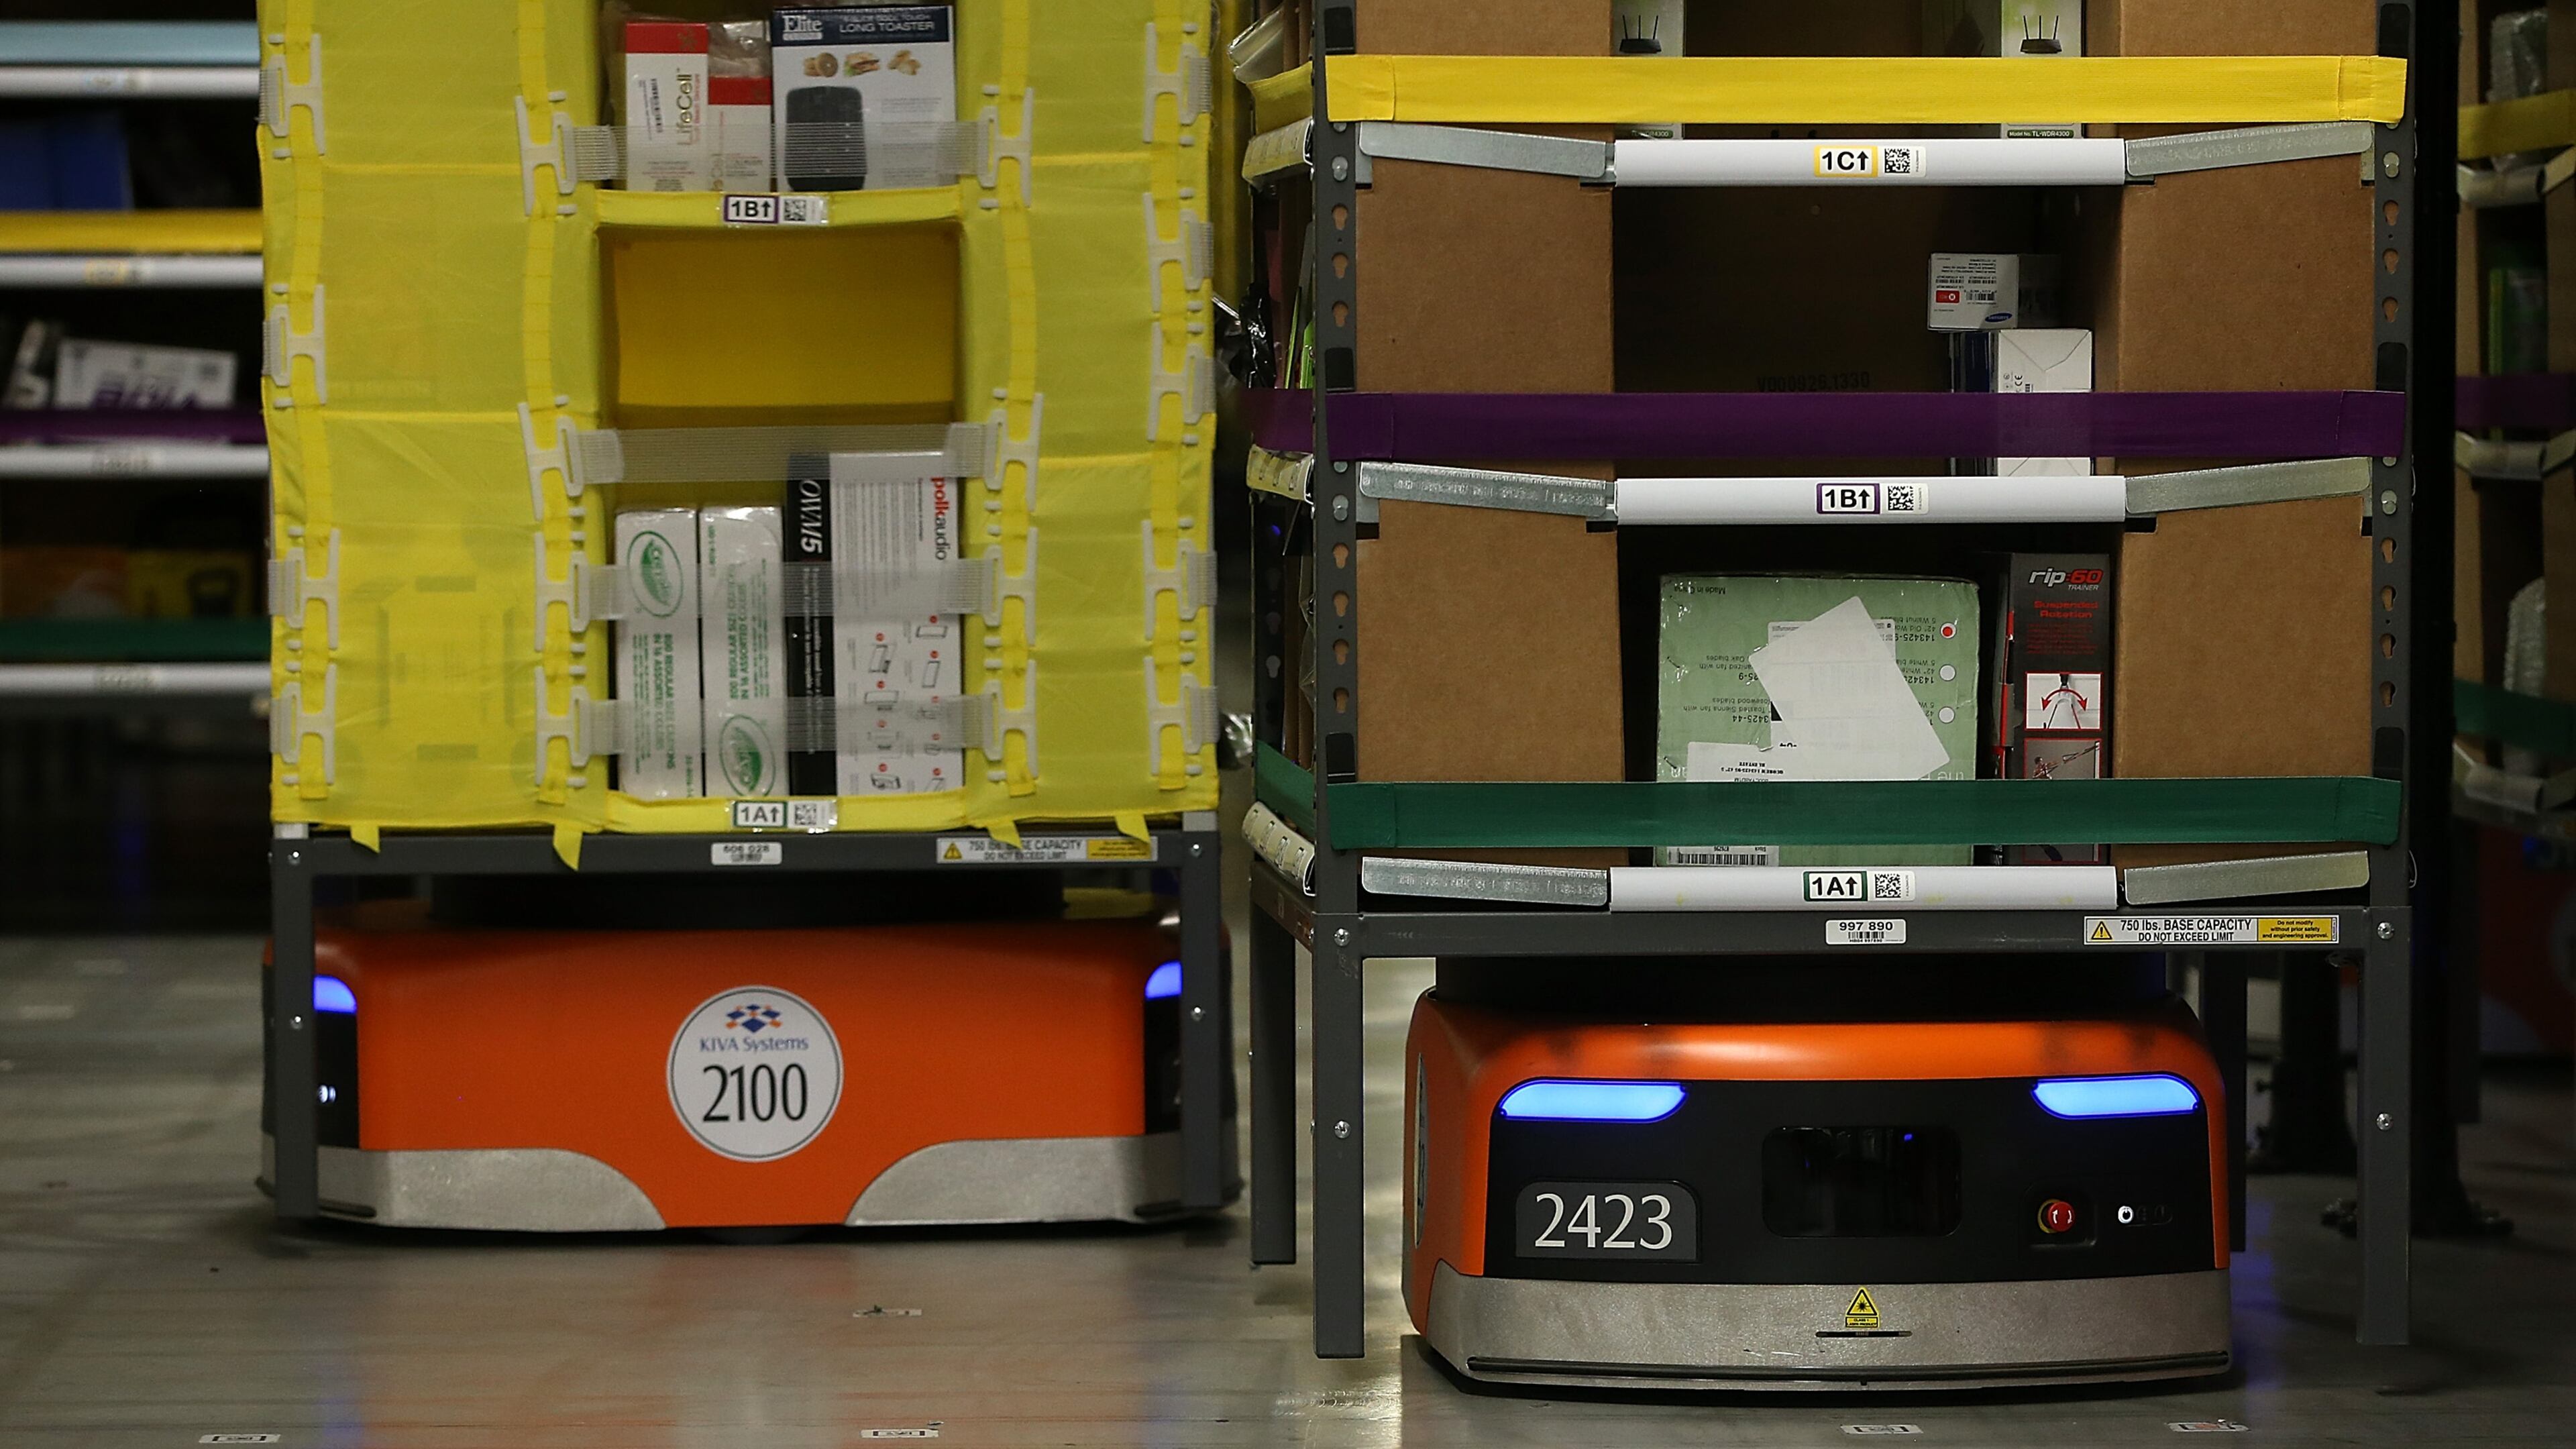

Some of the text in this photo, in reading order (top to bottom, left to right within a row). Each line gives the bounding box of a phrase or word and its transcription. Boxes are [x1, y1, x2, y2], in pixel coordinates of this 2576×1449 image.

[782, 15, 824, 32] Elite
[839, 21, 935, 33] LONG TOASTER
[1821, 151, 1855, 170] 1C
[731, 201, 759, 217] 1B
[1825, 488, 1858, 508] 1B
[798, 479, 823, 555] OWM5
[930, 477, 951, 561] polkaudio
[2028, 567, 2103, 588] rip:60
[1674, 586, 1695, 595] Cina
[1705, 587, 1726, 595] Made
[2034, 601, 2099, 609] Suspended
[2040, 610, 2093, 618] Rotation
[727, 634, 737, 678] REGULAR
[738, 623, 749, 674] ASSORTED
[665, 654, 675, 699] REGULAR
[741, 806, 768, 822] 1A
[1034, 839, 1082, 850] CAPACITY
[998, 851, 1013, 859] NOT
[1014, 851, 1045, 859] EXCEED
[1047, 851, 1067, 859] LIMIT
[1811, 876, 1845, 896] 1A
[1839, 922, 1894, 931] 997 890
[2120, 919, 2252, 931] 750 lbs. BASE CAPACITY
[2138, 932, 2235, 942] DO NOT EXCEED LIMIT
[700, 1036, 810, 1054] KIVA Systems
[702, 1063, 808, 1123] 2100
[1534, 1192, 1674, 1250] 2423
